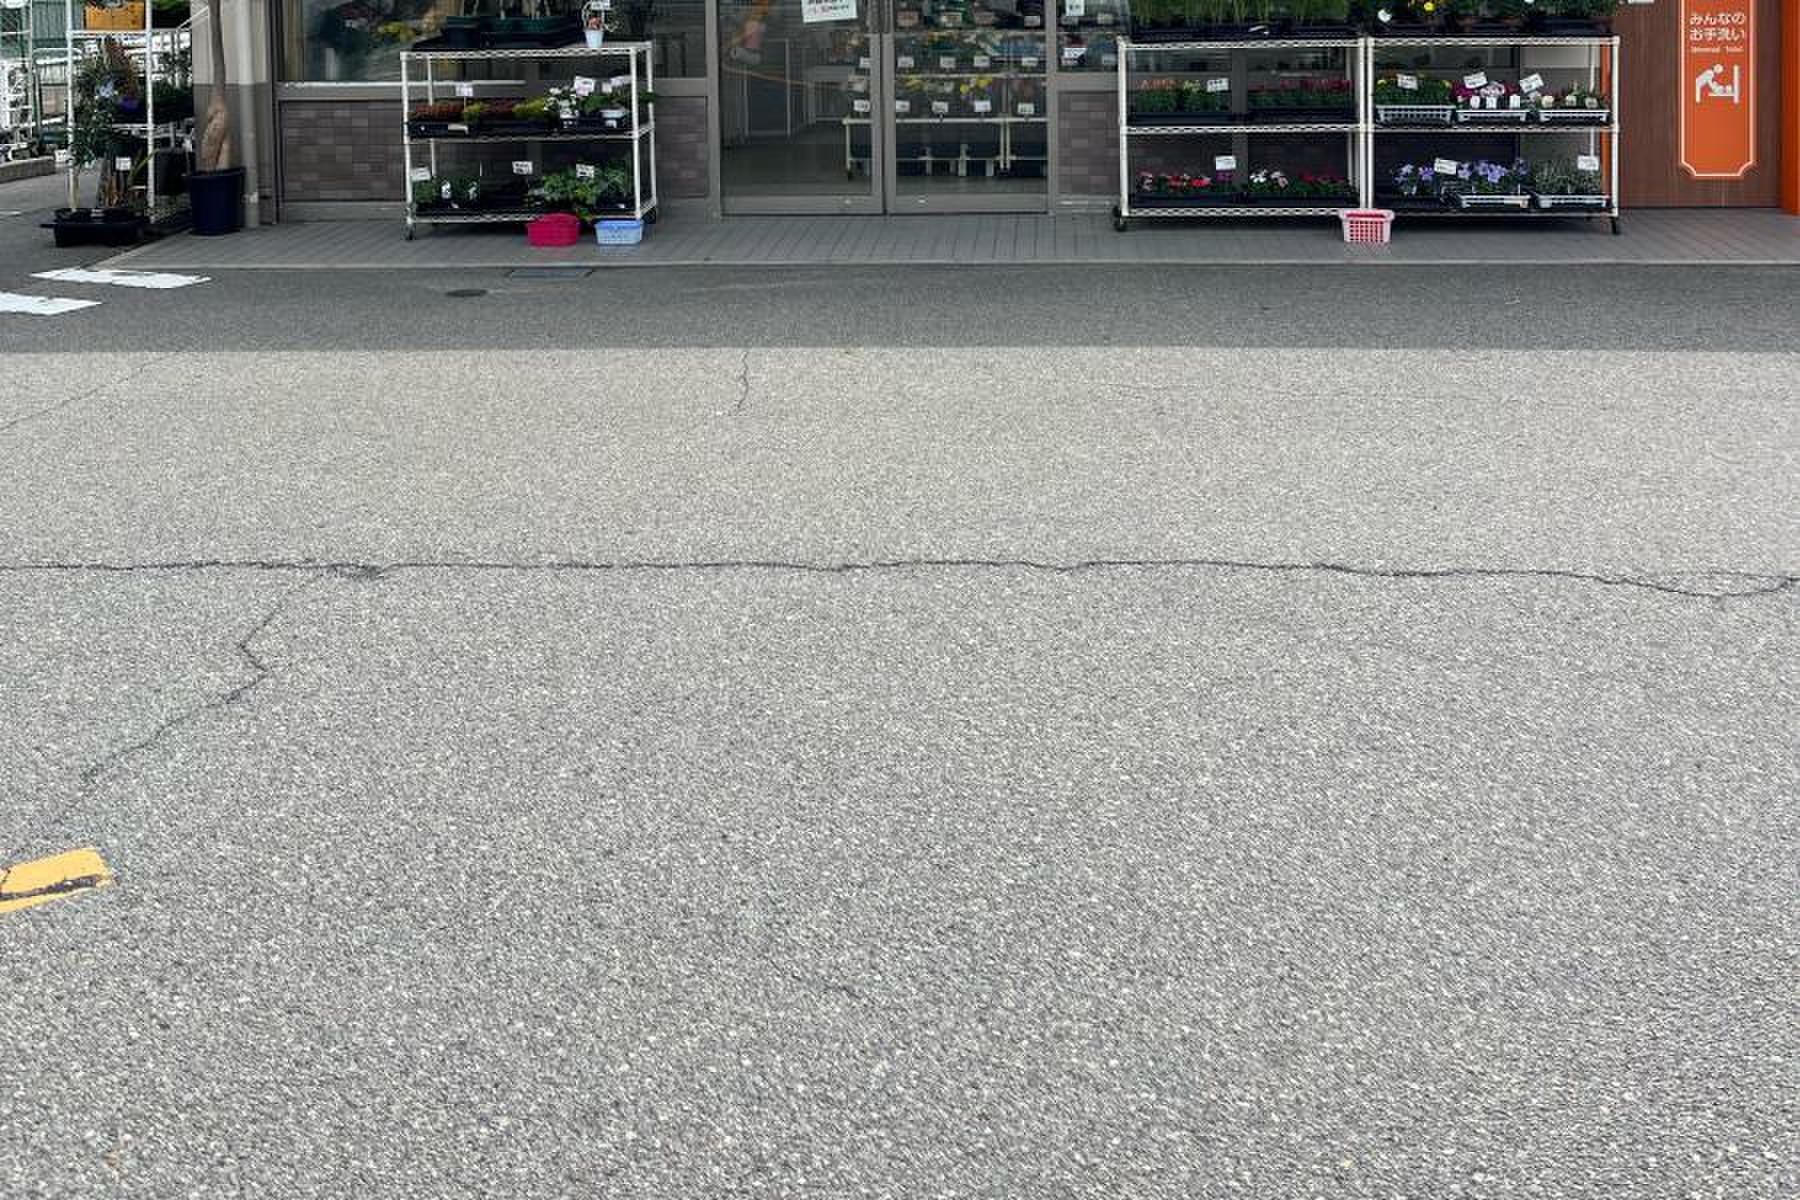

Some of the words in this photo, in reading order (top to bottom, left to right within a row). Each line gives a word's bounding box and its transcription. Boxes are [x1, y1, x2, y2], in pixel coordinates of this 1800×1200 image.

[1690, 12, 1745, 25] みんなの
[1690, 27, 1745, 41] お手洗い
